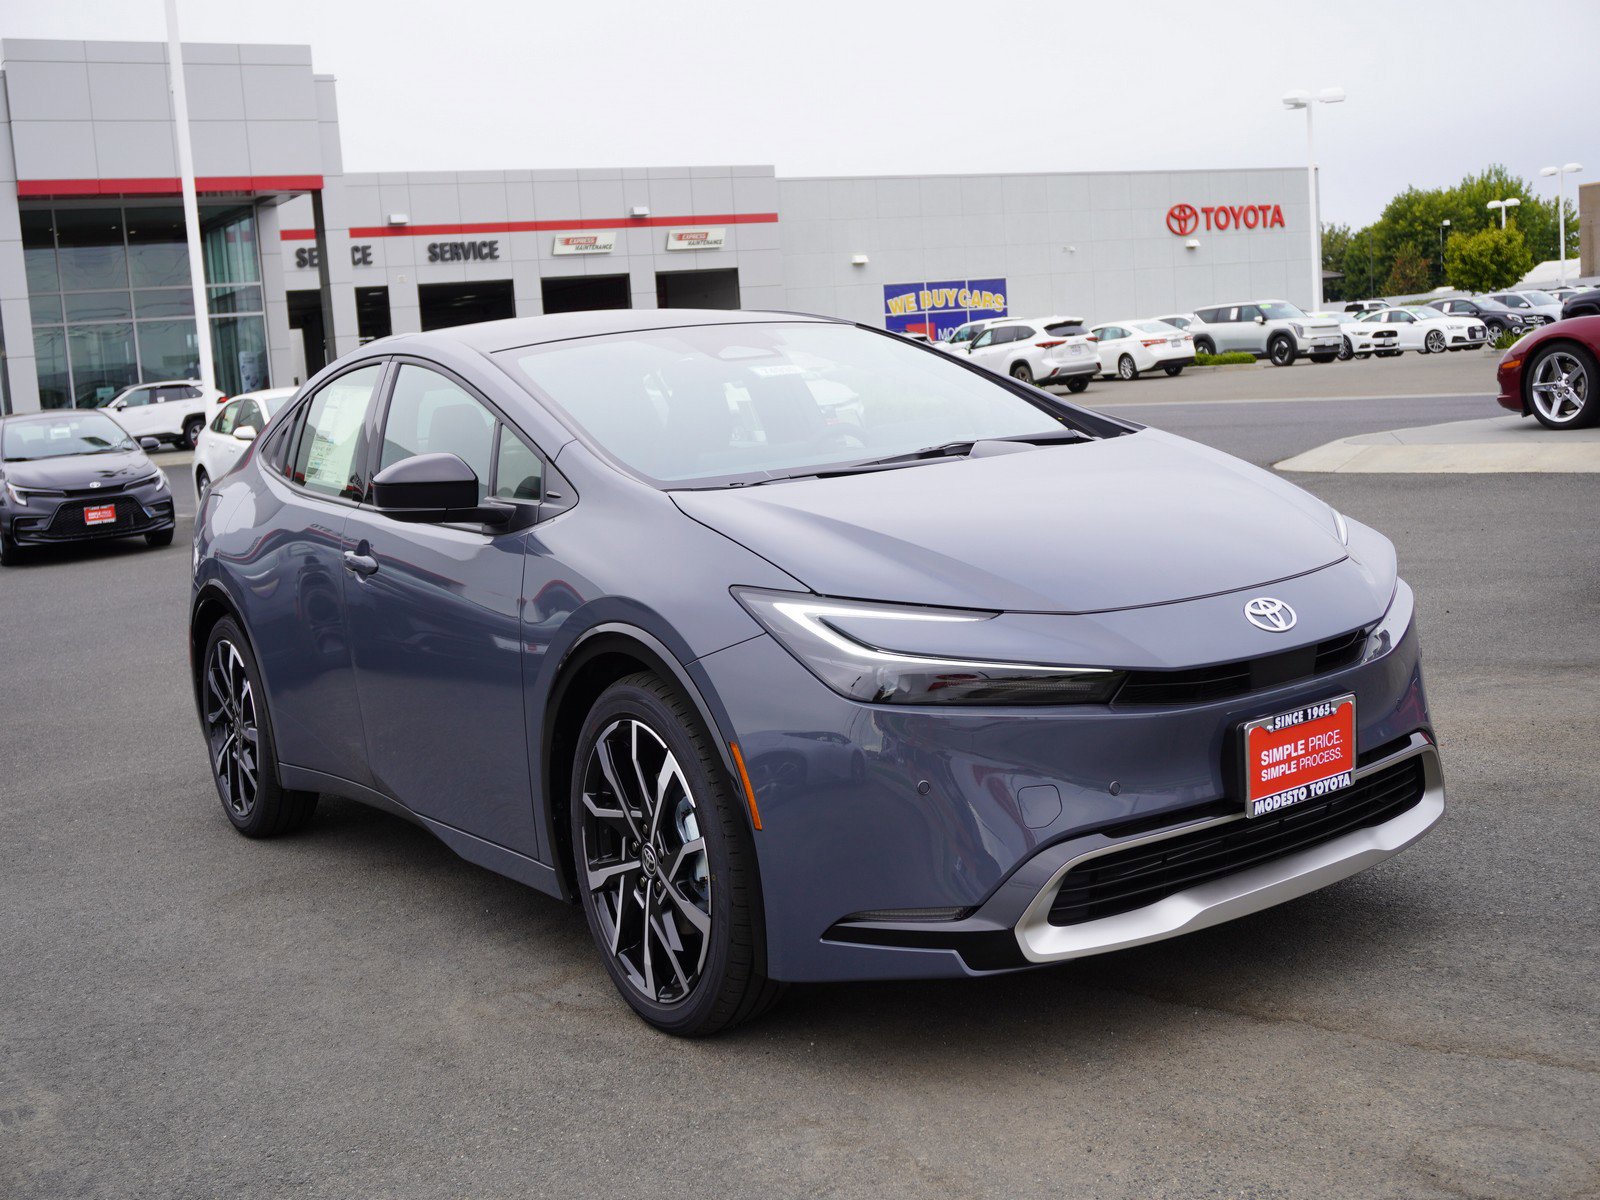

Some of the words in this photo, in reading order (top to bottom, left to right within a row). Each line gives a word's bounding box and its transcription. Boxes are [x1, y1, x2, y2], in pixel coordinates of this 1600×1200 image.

[1201, 204, 1285, 230] TOYOTA
[427, 240, 499, 262] SERVICE
[887, 292, 918, 317] WE
[919, 288, 959, 309] BUY
[958, 289, 1004, 311] CARS
[1275, 710, 1304, 729] SINCE
[1307, 703, 1330, 720] 1965
[1260, 740, 1305, 766] SIMPLE
[1308, 729, 1343, 752] PRICE.
[1261, 760, 1297, 782] SIMPLE
[1299, 748, 1343, 770] PROCESS.
[1254, 786, 1307, 816] MODESTO
[1310, 774, 1351, 797] TOYOTA
